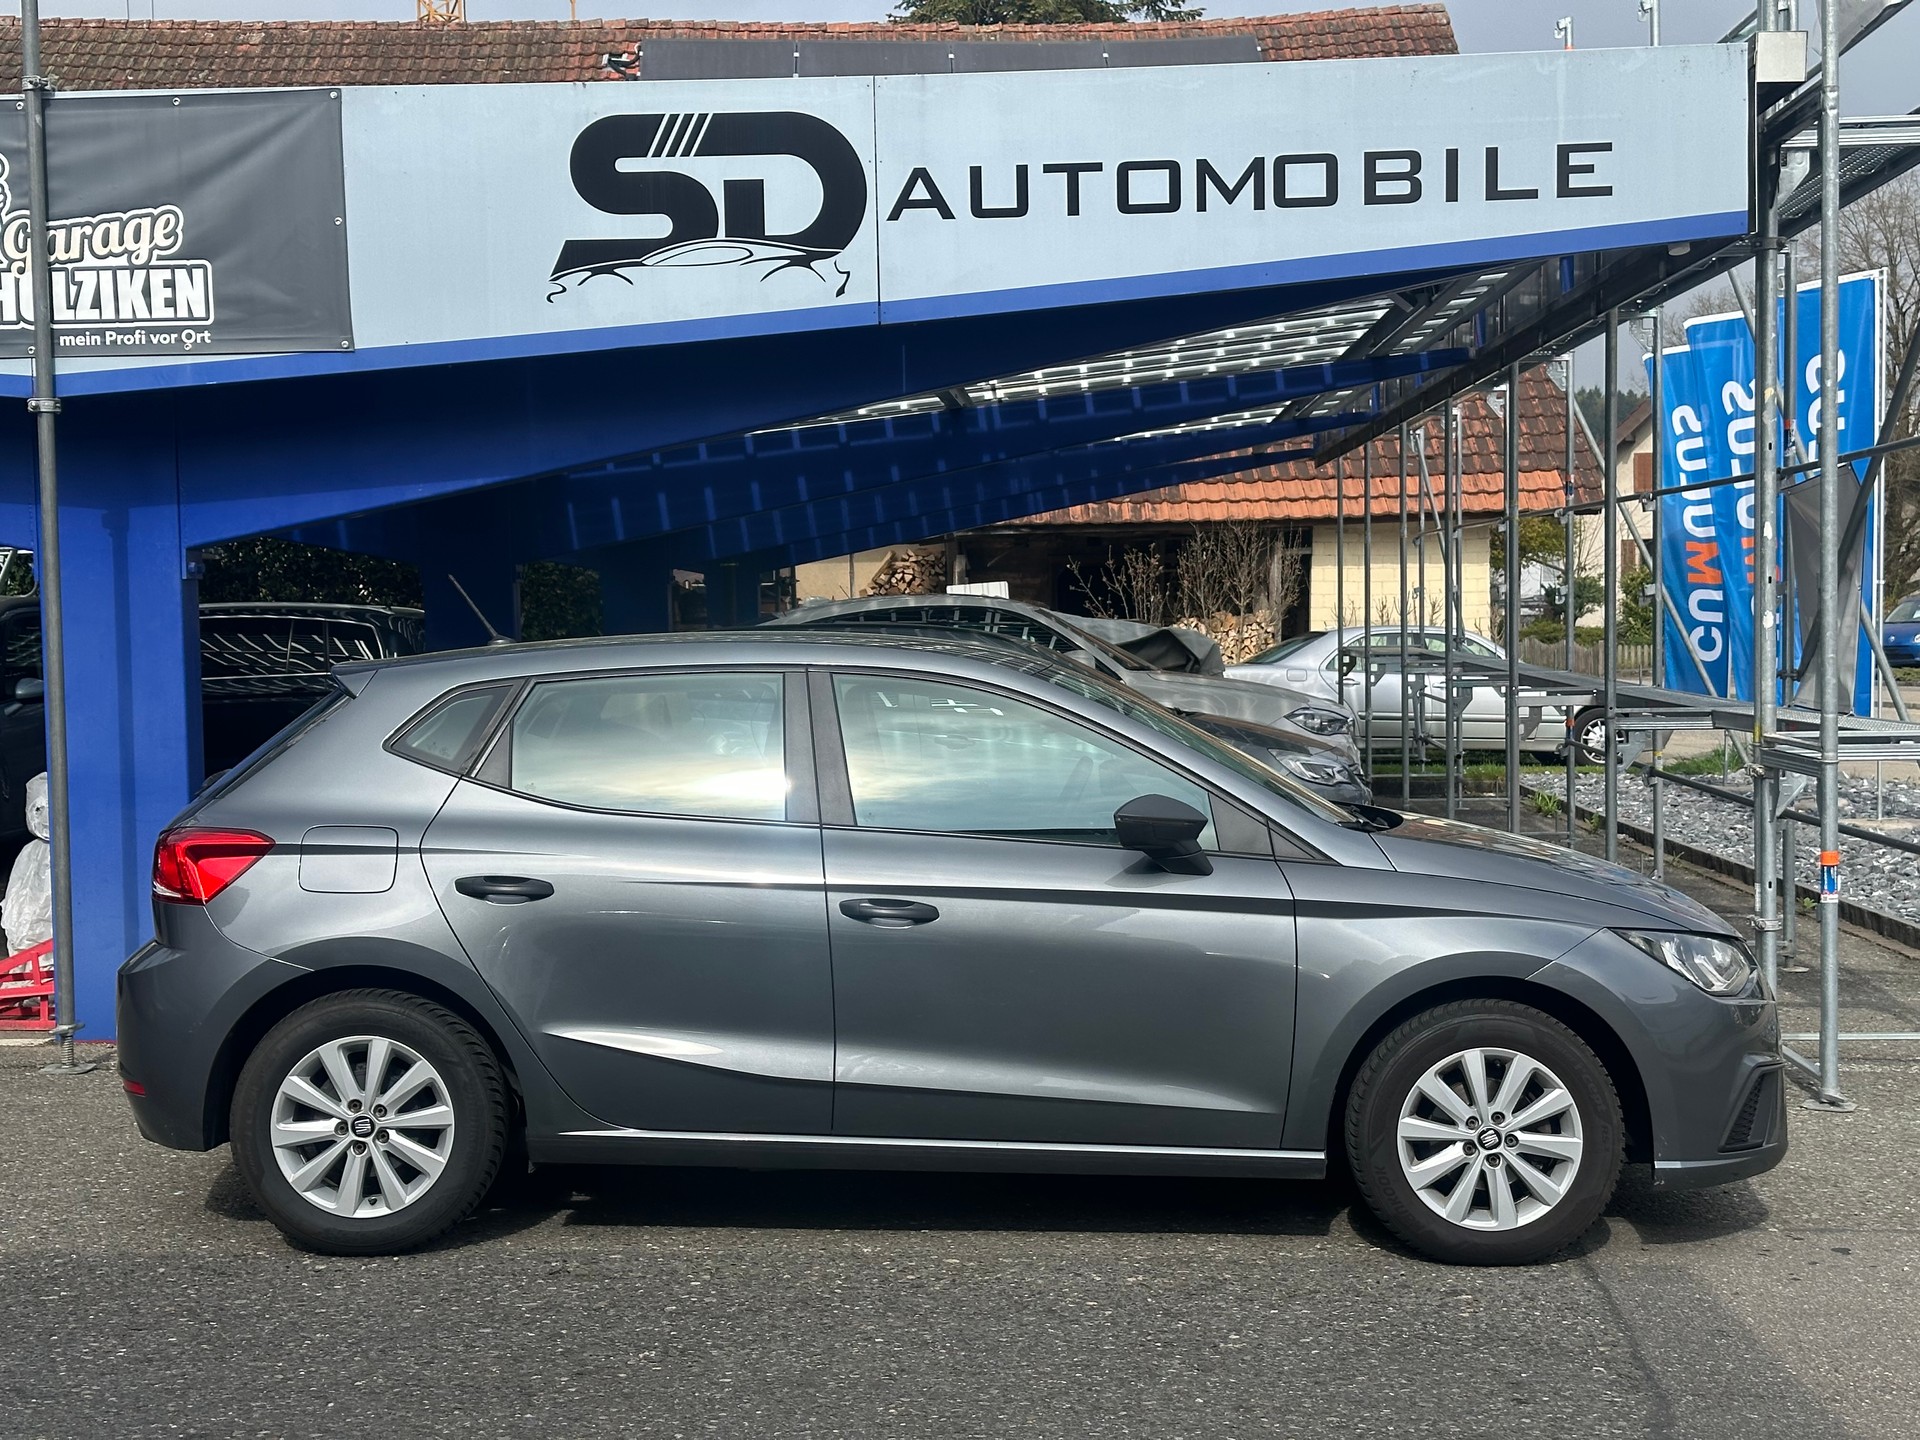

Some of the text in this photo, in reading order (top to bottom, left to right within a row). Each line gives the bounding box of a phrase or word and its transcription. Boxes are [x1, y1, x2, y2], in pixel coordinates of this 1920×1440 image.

[548, 110, 1614, 282] SD AUTOMOBILE
[59, 329, 212, 346] mein Profi vor Ort
